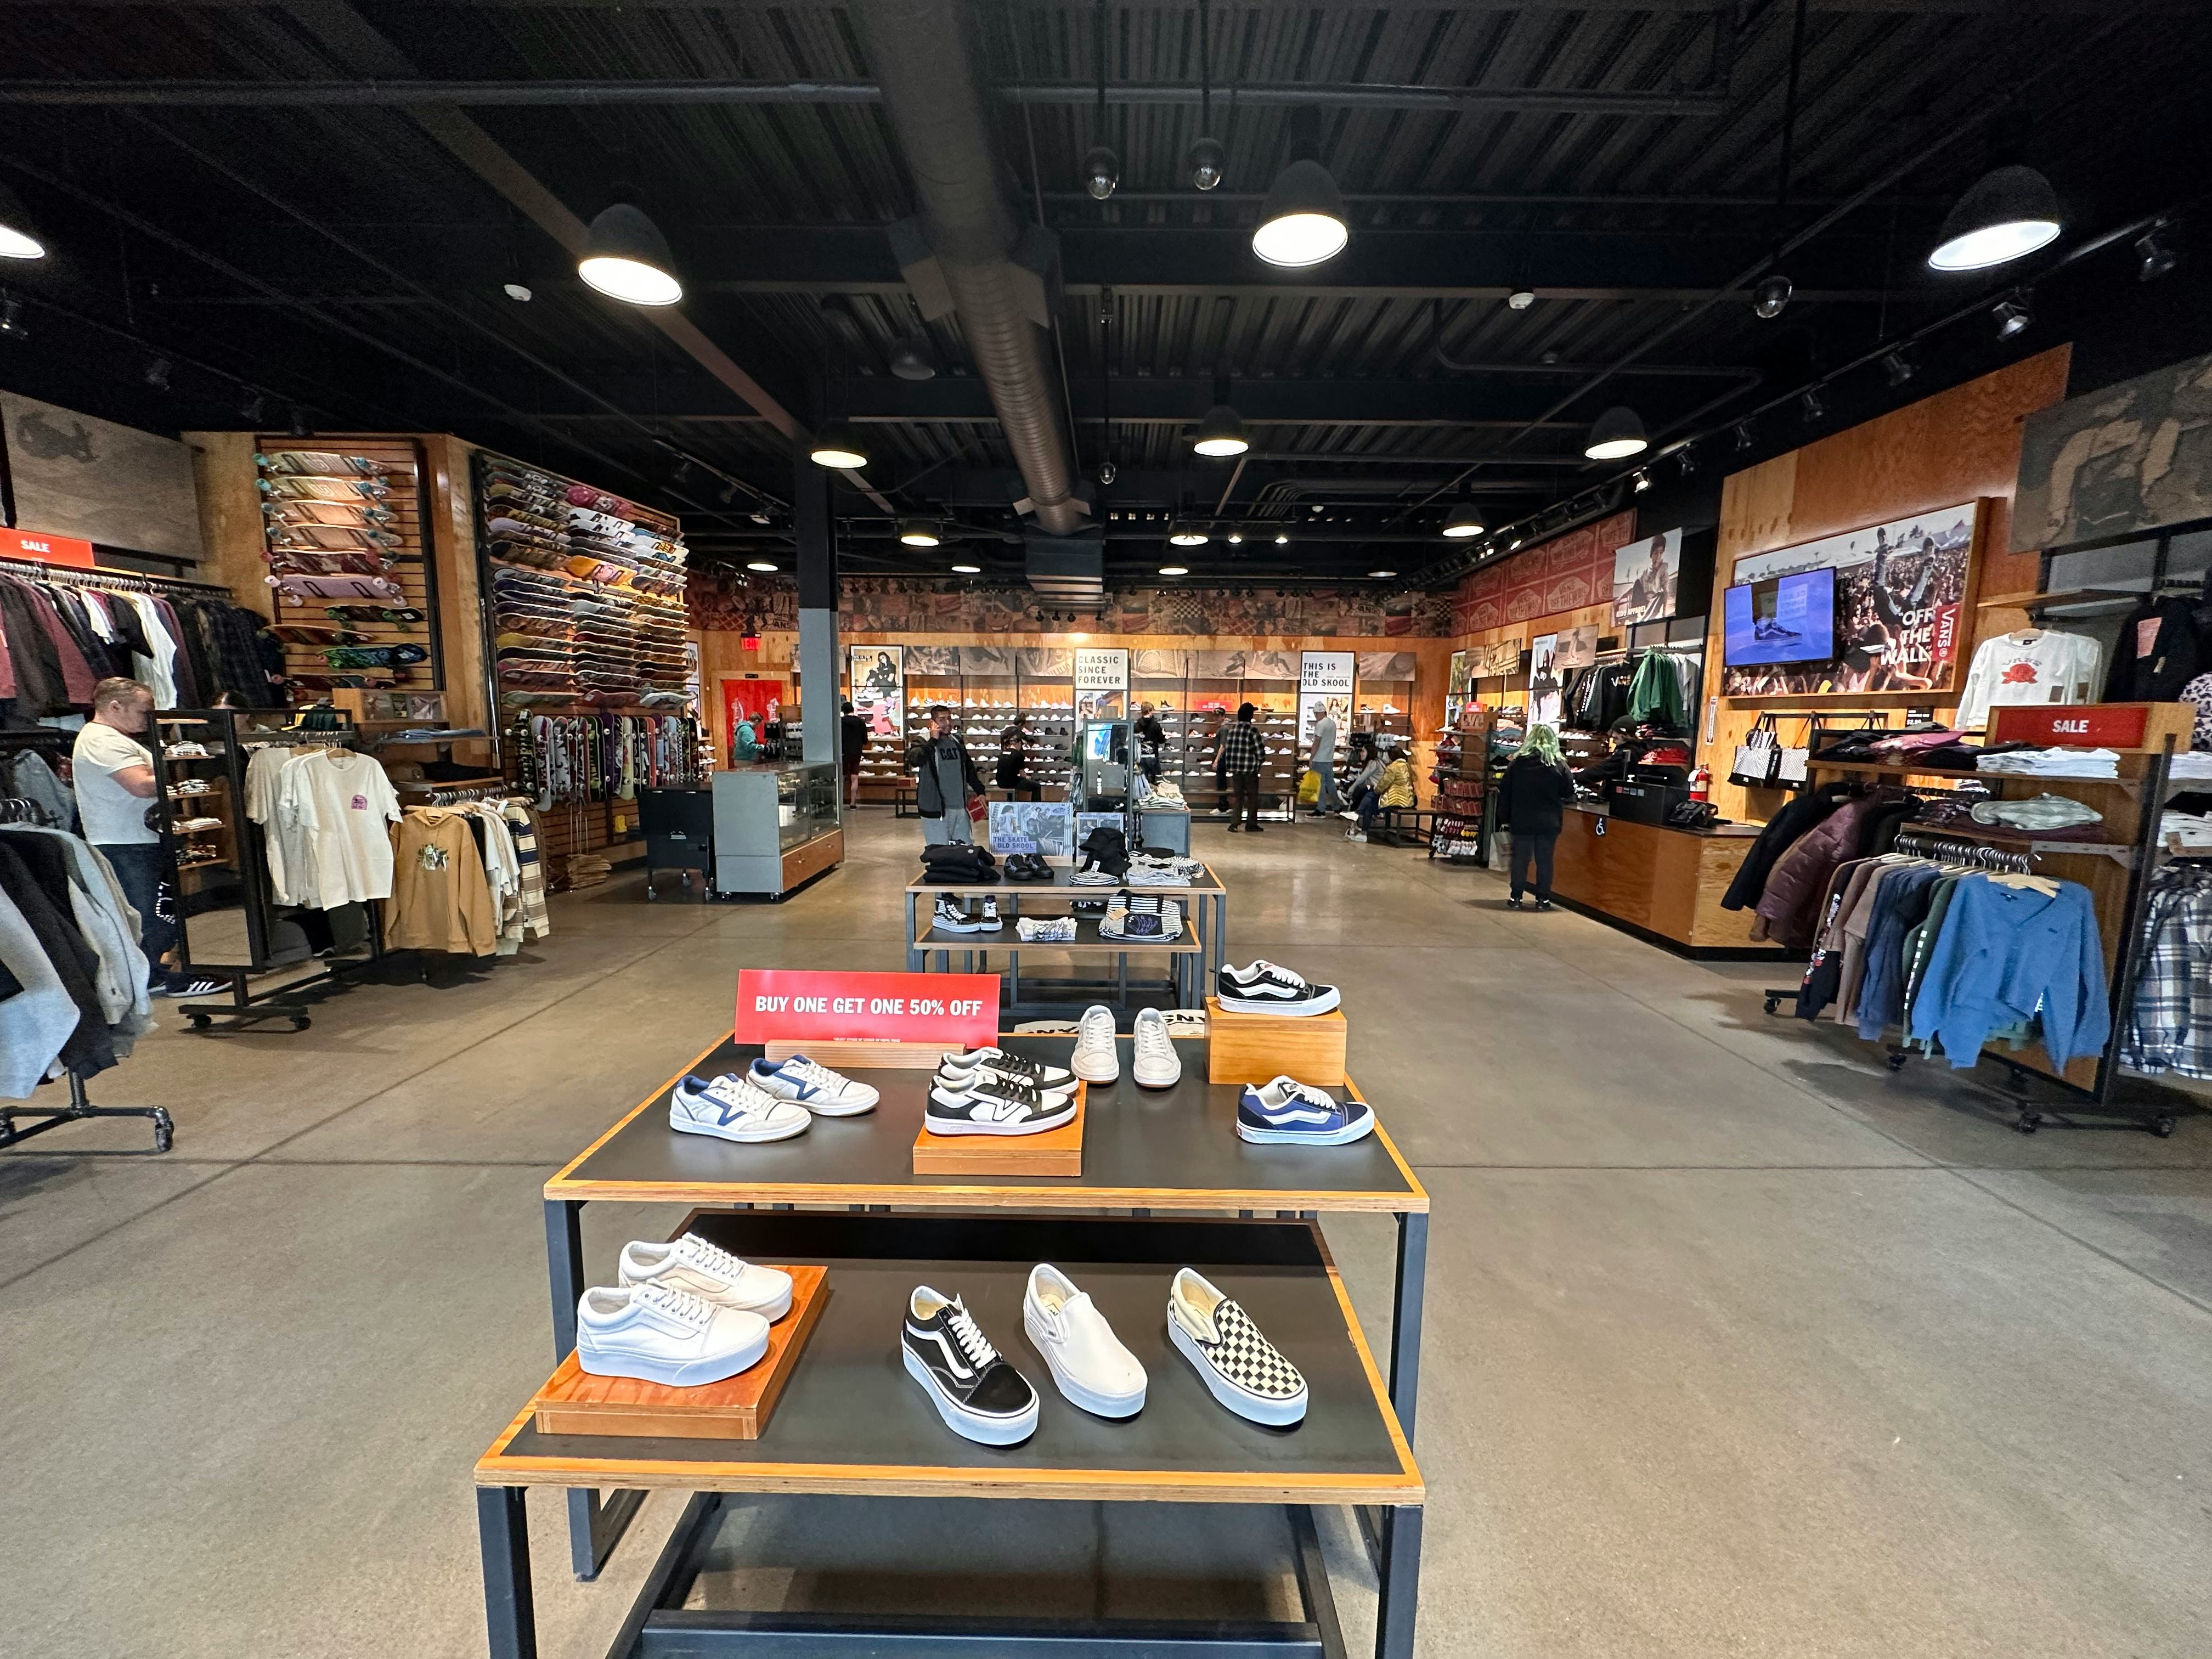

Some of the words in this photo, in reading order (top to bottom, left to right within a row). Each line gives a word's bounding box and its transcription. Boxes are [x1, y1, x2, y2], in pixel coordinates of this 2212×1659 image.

[21, 540, 50, 553] SALE
[1900, 626, 1932, 645] THE
[1079, 676, 1120, 684] FOREVER
[2052, 720, 2089, 733] SALE
[939, 748, 958, 760] CAT
[755, 996, 789, 1013] BUY
[793, 997, 827, 1014] ONE
[833, 997, 865, 1014] GET
[870, 998, 904, 1015] ONE
[910, 999, 944, 1016] 50%
[950, 1000, 983, 1016] OFF
